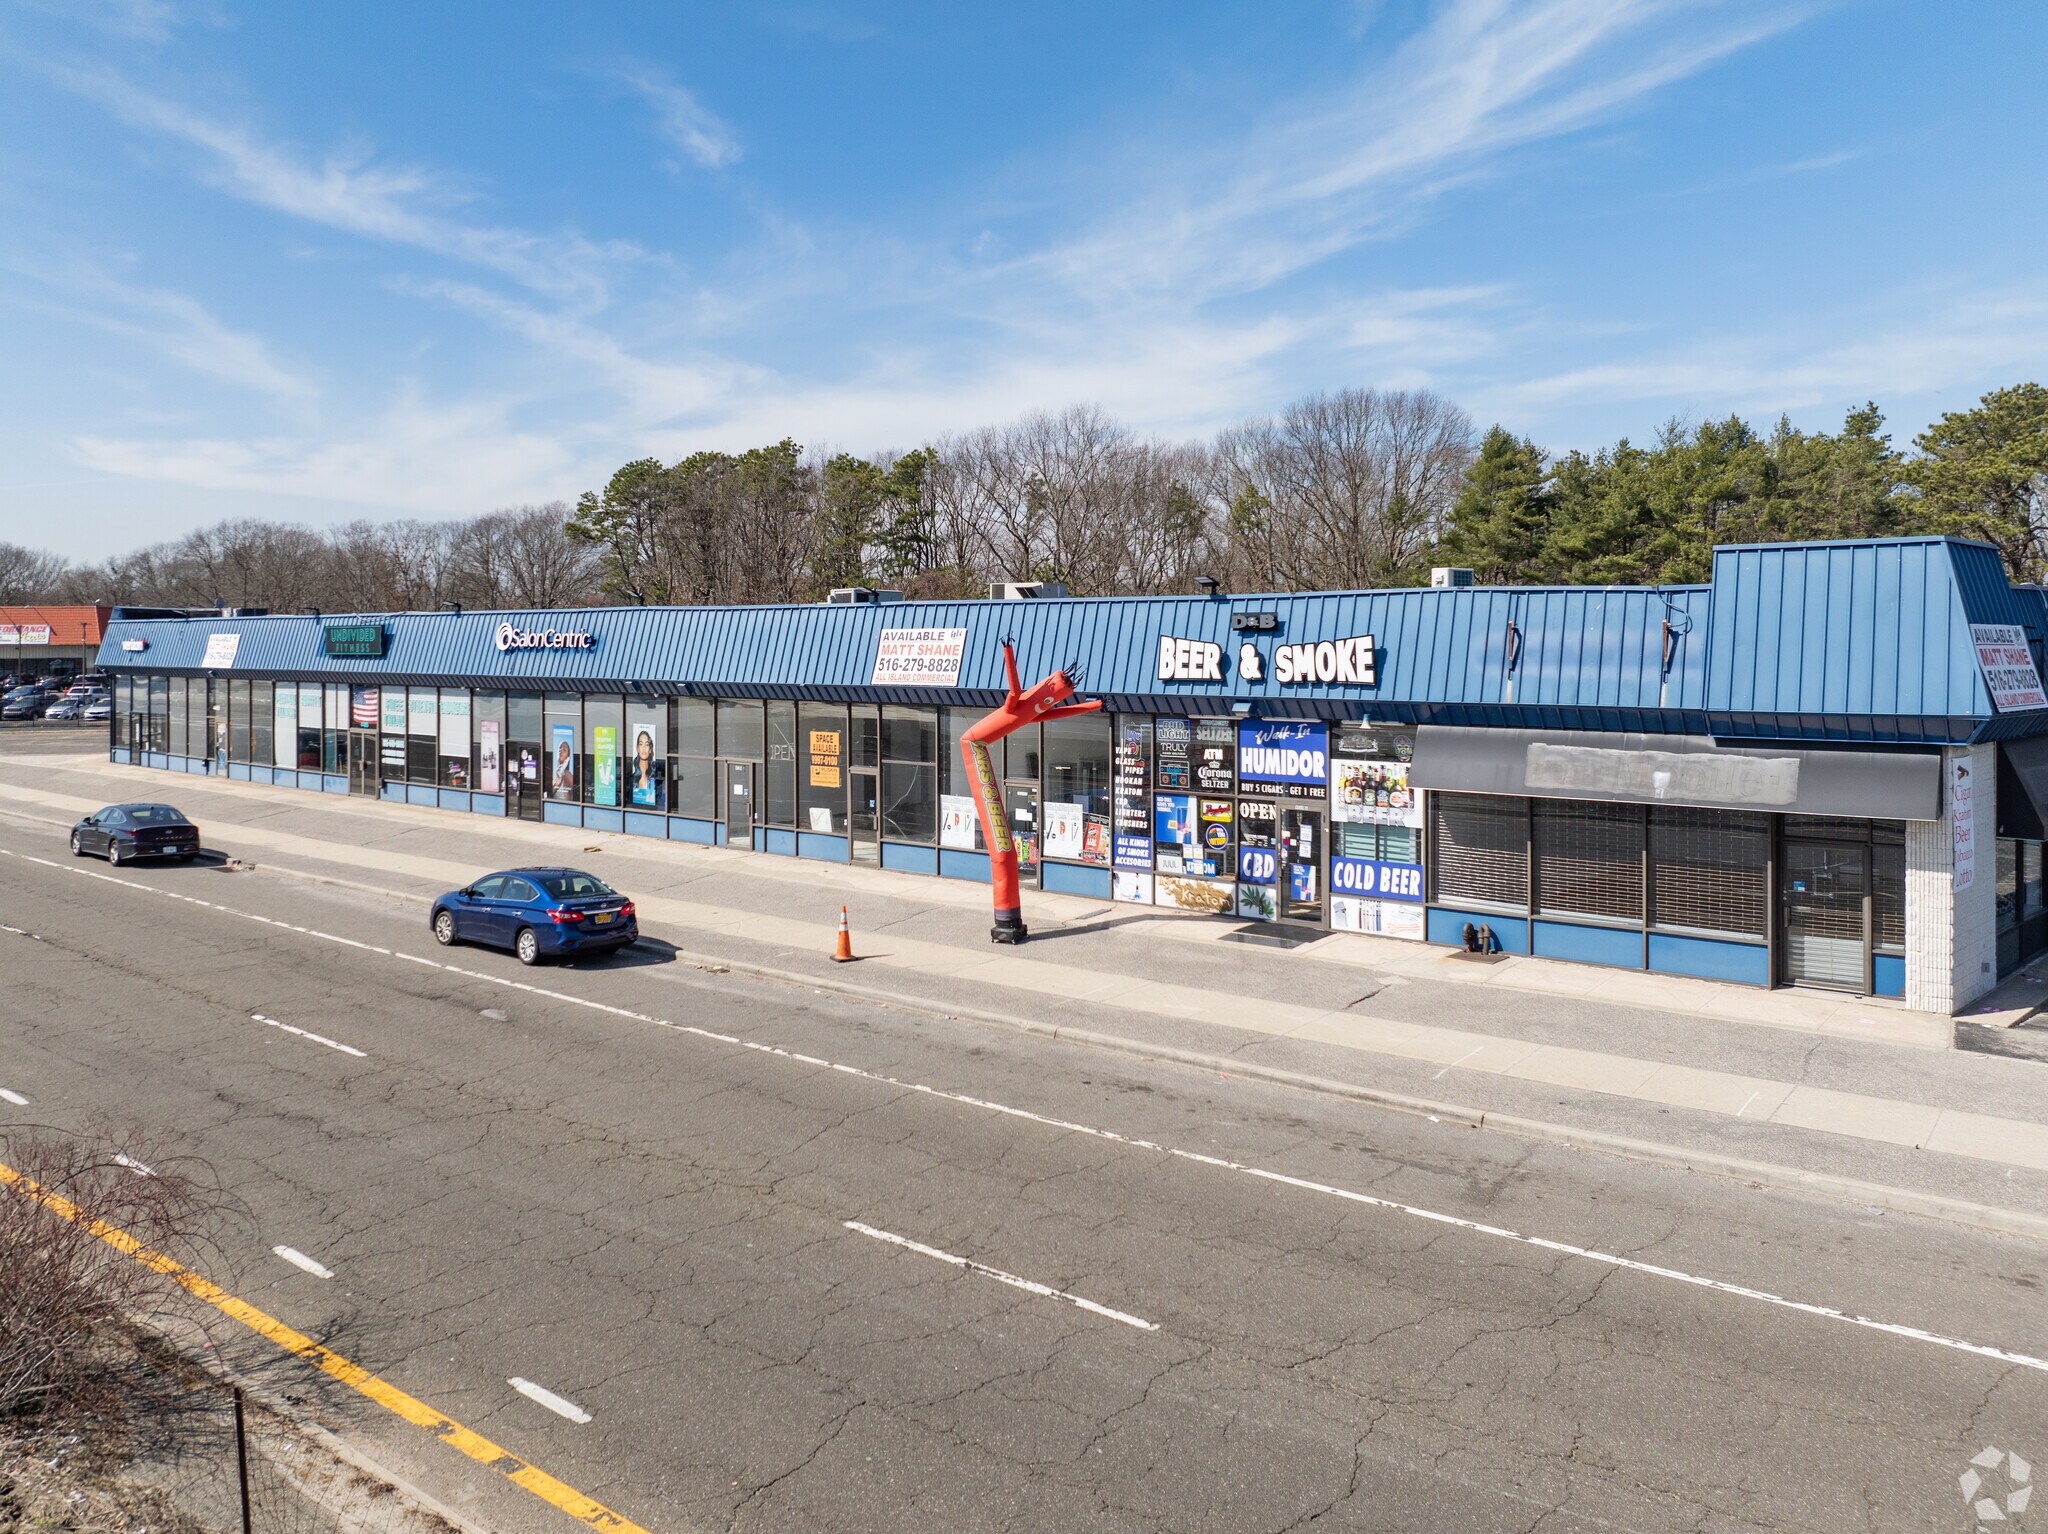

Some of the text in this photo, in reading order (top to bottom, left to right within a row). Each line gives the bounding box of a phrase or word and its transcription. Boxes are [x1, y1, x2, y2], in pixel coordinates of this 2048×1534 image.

[1234, 614, 1276, 629] D&B
[330, 628, 376, 643] UNDIVIDED
[511, 628, 590, 648] SalonCentric
[882, 631, 946, 641] AVAILABLE
[1974, 628, 2014, 643] AVAILABLE
[335, 643, 370, 652] FITNESS
[881, 644, 960, 656] MATT SHANE
[1158, 634, 1375, 685] BEER & SMOKE
[1979, 648, 2030, 666] MATT SHANE
[878, 657, 958, 673] 516-279-8828
[875, 673, 955, 683] ALL ISLAND COMMERCIAL
[1162, 720, 1185, 730] BUD
[816, 734, 834, 743] SPACE
[1159, 729, 1189, 740] LIGHT
[1196, 725, 1233, 742] SELTZER
[1255, 723, 1311, 745] Walk-In
[813, 744, 837, 753] AVAILABLE
[1115, 746, 1132, 755] VAPE
[1160, 742, 1188, 752] TRULY
[1203, 748, 1224, 760] ATM
[1115, 757, 1135, 766] GLASS
[1241, 747, 1326, 778] HUMIDOR
[1125, 766, 1144, 775] PIPES
[1197, 766, 1232, 779] Corona
[1115, 776, 1143, 786] HOOKAH
[1201, 780, 1229, 788] SELTZER
[1115, 786, 1143, 796] KRATOM
[1241, 782, 1254, 792] BUY
[1255, 784, 1260, 793] 5
[1261, 784, 1283, 794] CIGARS
[1289, 786, 1303, 795] GET
[1303, 787, 1307, 796] 1
[1309, 787, 1325, 797] FREE
[1115, 797, 1128, 806] CBD
[1115, 807, 1147, 818] LIGHTERS
[1239, 802, 1277, 820] OPEN
[1346, 804, 1406, 828] BEER
[985, 800, 1012, 852] BEER
[1115, 818, 1148, 829] CRUSHERS
[1955, 826, 1971, 844] Beer
[1117, 837, 1149, 848] ALL KINDS
[1118, 847, 1127, 855] OF
[1127, 848, 1149, 858] SMOKE
[1115, 856, 1152, 868] ACCESORIES
[1242, 852, 1275, 878] CBD
[1333, 862, 1421, 897] COLD BEER
[1181, 889, 1231, 907] Kratom
